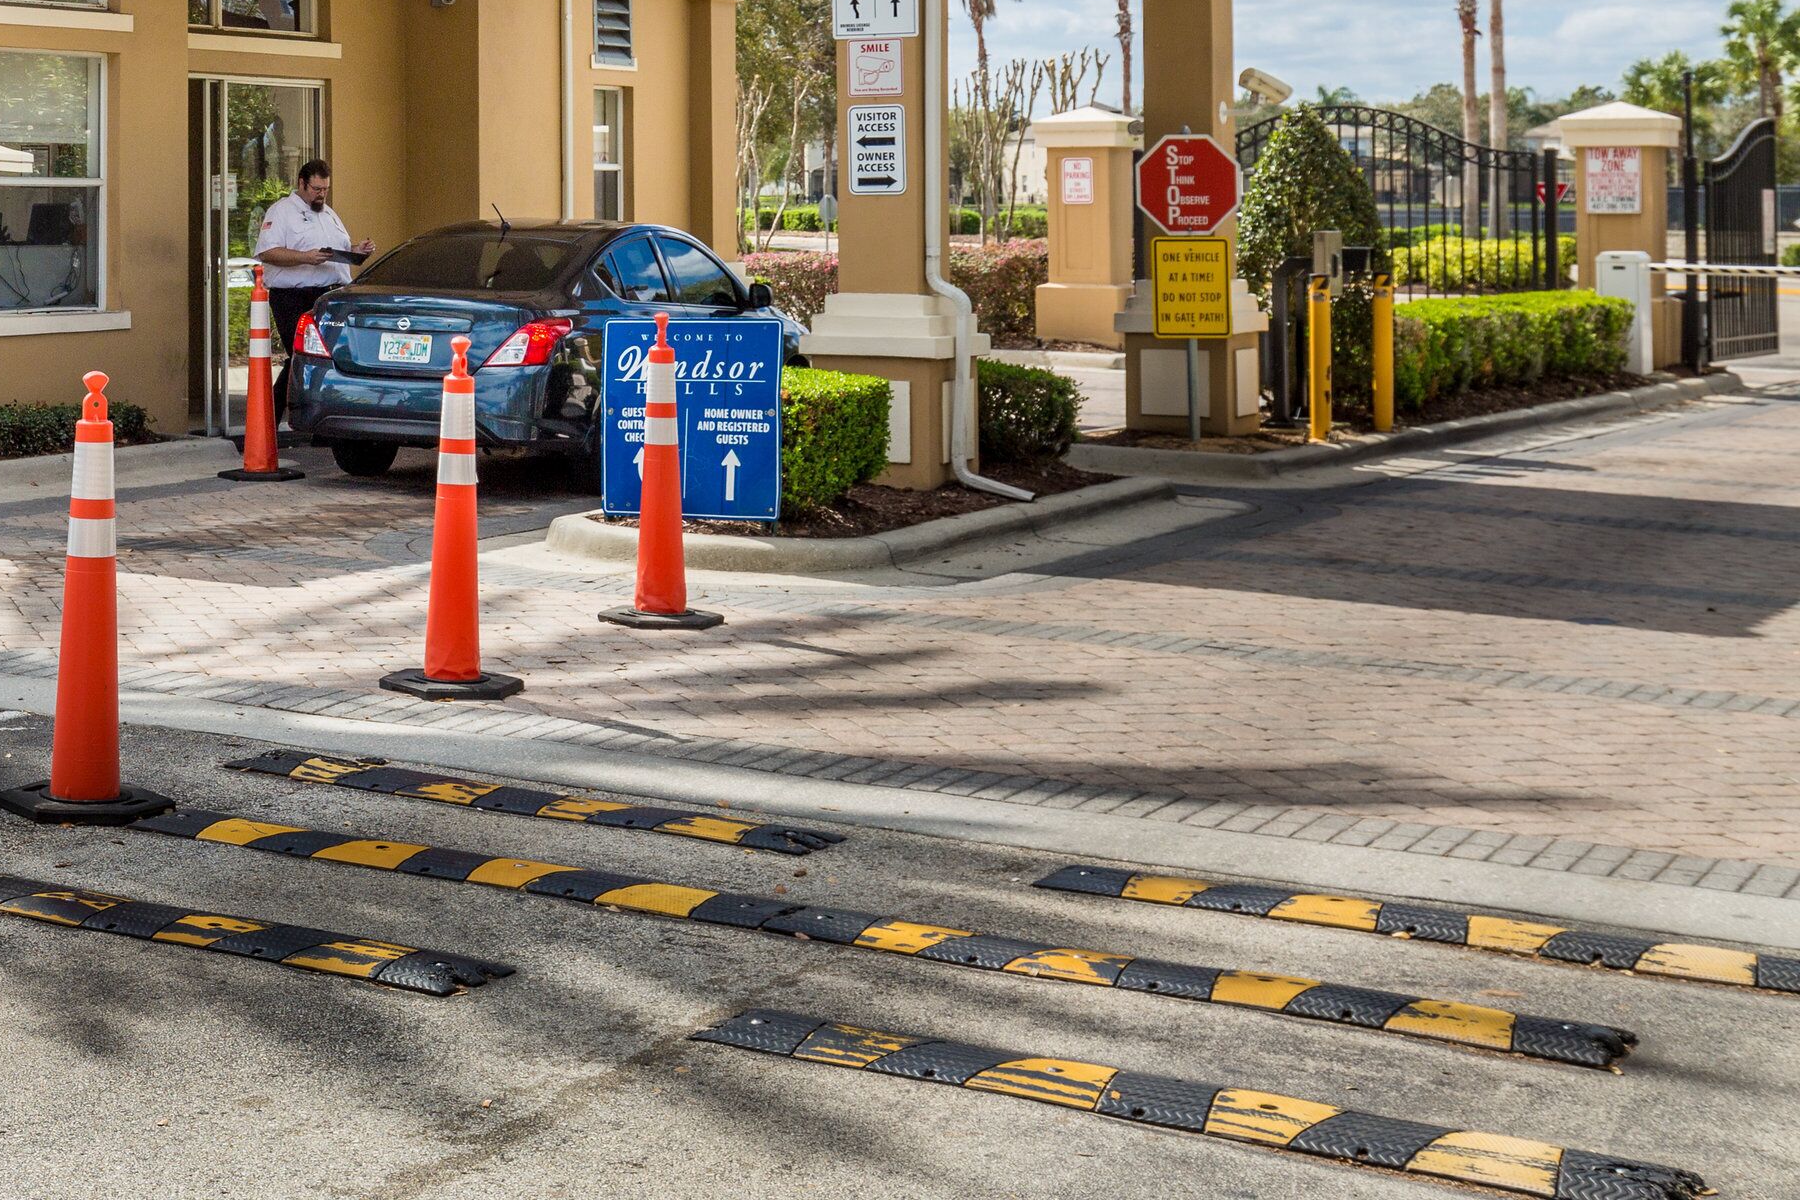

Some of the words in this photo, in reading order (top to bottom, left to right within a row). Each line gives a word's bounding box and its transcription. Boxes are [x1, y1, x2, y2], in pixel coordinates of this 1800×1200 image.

[860, 43, 890, 53] SMILE
[856, 112, 897, 121] VISITOR
[857, 123, 896, 132] ACCESS
[857, 152, 895, 161] OWNER
[1612, 147, 1639, 159] AWAY
[857, 163, 896, 172] ACCESS
[1073, 162, 1081, 170] NO
[1602, 160, 1625, 171] ZONE
[1162, 252, 1180, 262] ONE
[1184, 252, 1220, 262] VEHICLE
[1168, 272, 1178, 282] AT
[1182, 272, 1188, 282] A
[1191, 272, 1214, 282] TIME!
[1162, 292, 1176, 302] DO
[1179, 292, 1196, 302] NOT
[1200, 292, 1222, 302] STOP
[1161, 312, 1170, 322] IN
[1175, 312, 1195, 322] GATE
[1199, 312, 1224, 322] PATH!
[725, 334, 743, 342] TO
[618, 345, 764, 382] Wndsor
[636, 382, 743, 395] HLLS
[622, 407, 646, 418] GUEST
[704, 408, 728, 419] HOME
[730, 409, 763, 420] OWNER
[697, 421, 715, 431] AND
[717, 422, 770, 433] REGISTERED
[716, 434, 749, 445] GUESTS
